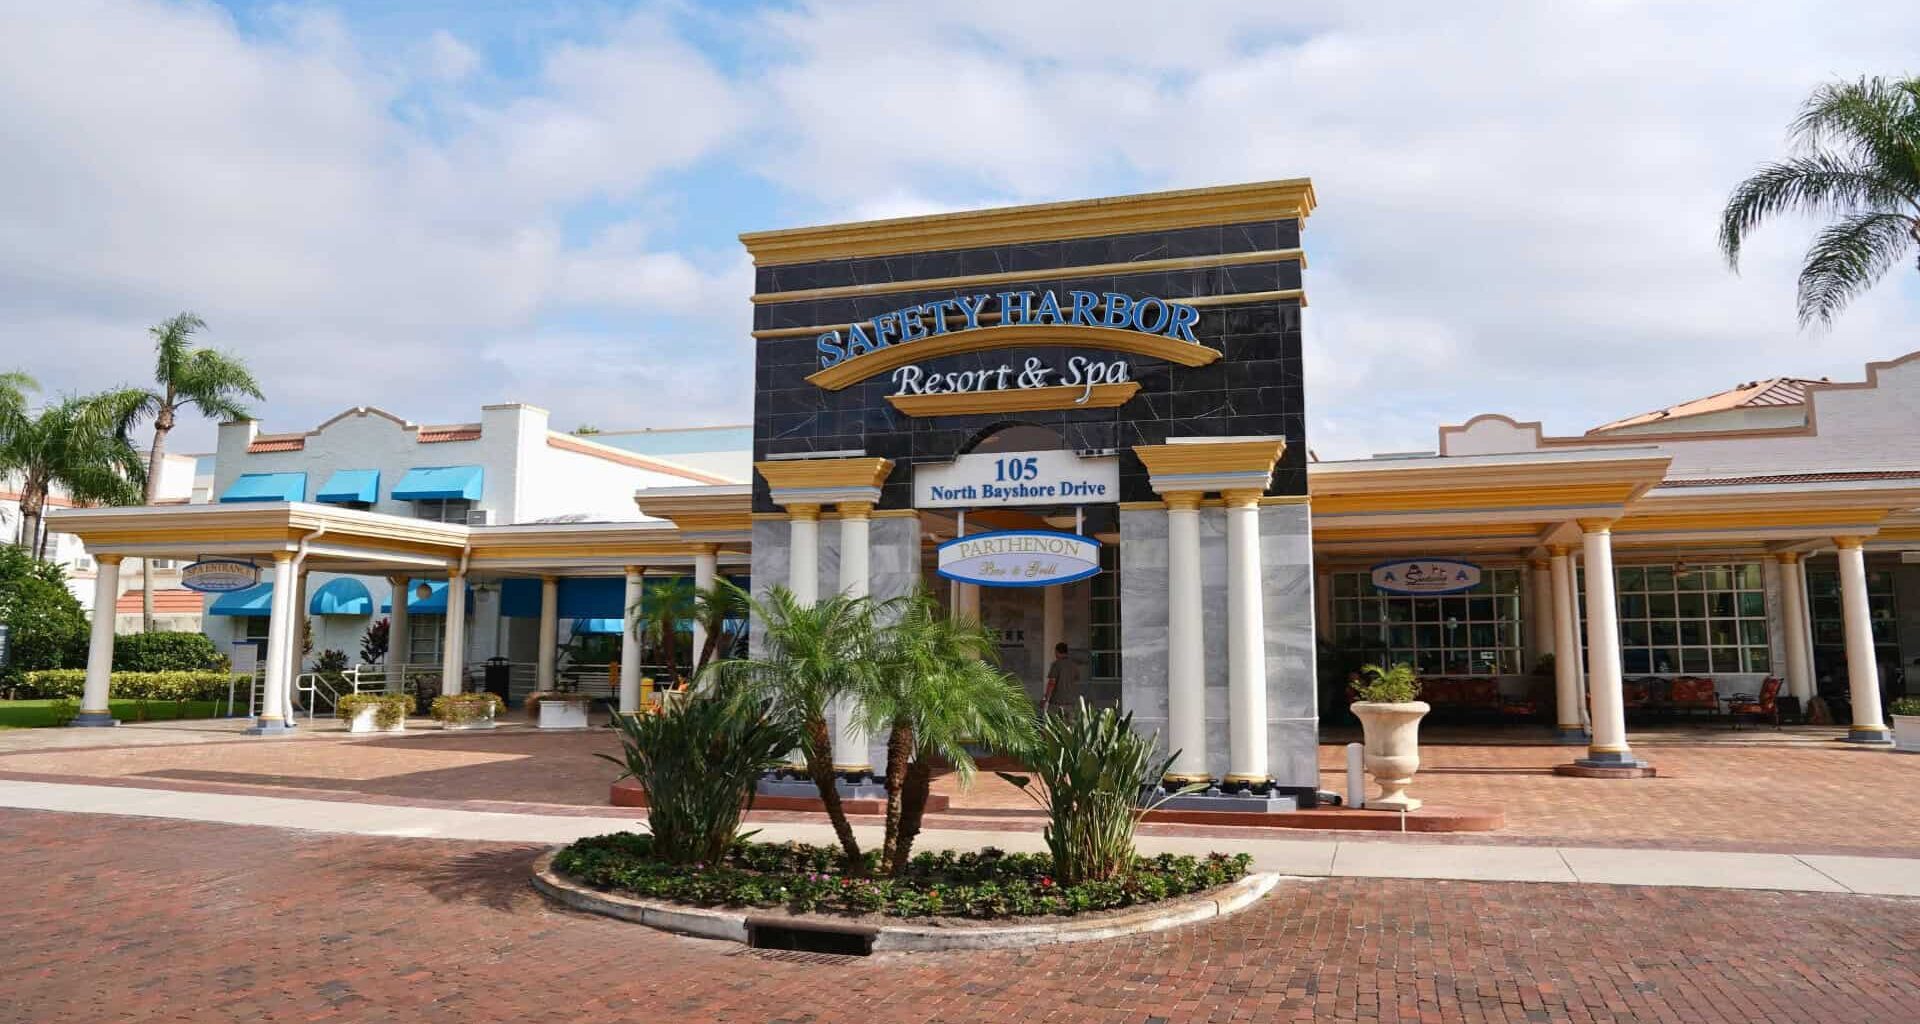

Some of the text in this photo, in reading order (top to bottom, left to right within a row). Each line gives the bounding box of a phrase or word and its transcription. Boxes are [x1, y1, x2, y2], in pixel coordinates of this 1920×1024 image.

[816, 290, 1201, 368] SAFETY HARBOR
[892, 356, 1130, 404] Resort & Spa
[995, 457, 1038, 481] 105
[931, 481, 1106, 501] North Bayshore Drive
[959, 537, 1081, 558] PARTHENON
[980, 561, 1006, 576] Bar
[1025, 560, 1058, 578] Grill
